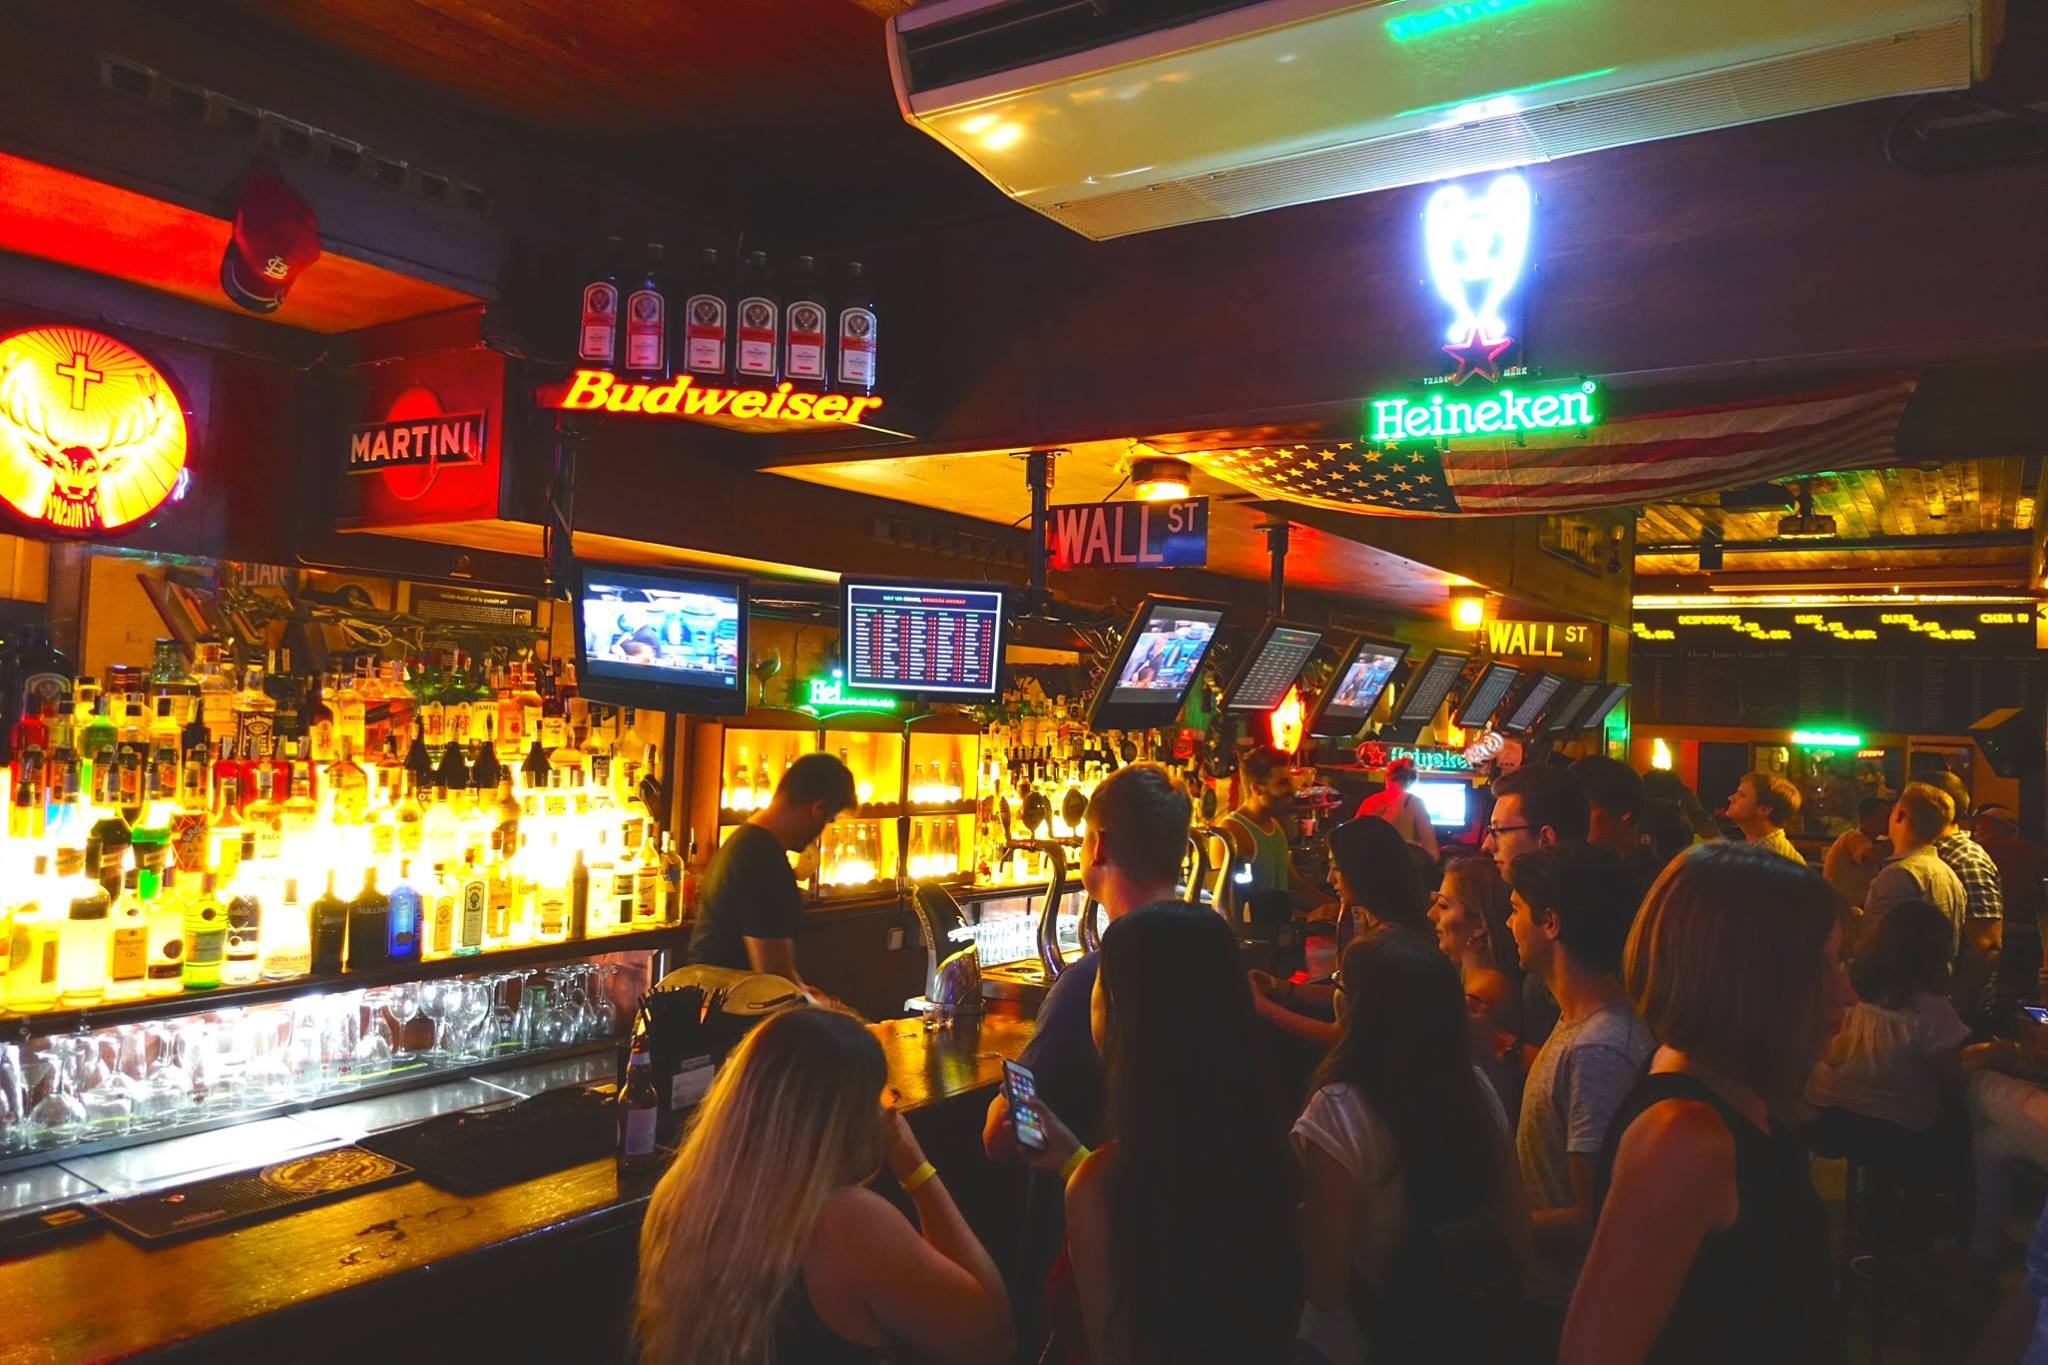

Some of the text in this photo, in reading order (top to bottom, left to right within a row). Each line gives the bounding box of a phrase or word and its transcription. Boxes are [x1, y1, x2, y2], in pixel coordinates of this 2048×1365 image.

[562, 369, 882, 424] Budweiser
[1372, 389, 1594, 440] Heineken
[350, 421, 472, 464] MARTINI
[1056, 502, 1200, 564] WALL ST
[1488, 622, 1588, 657] WALL ST
[1391, 747, 1472, 769] Hineke
